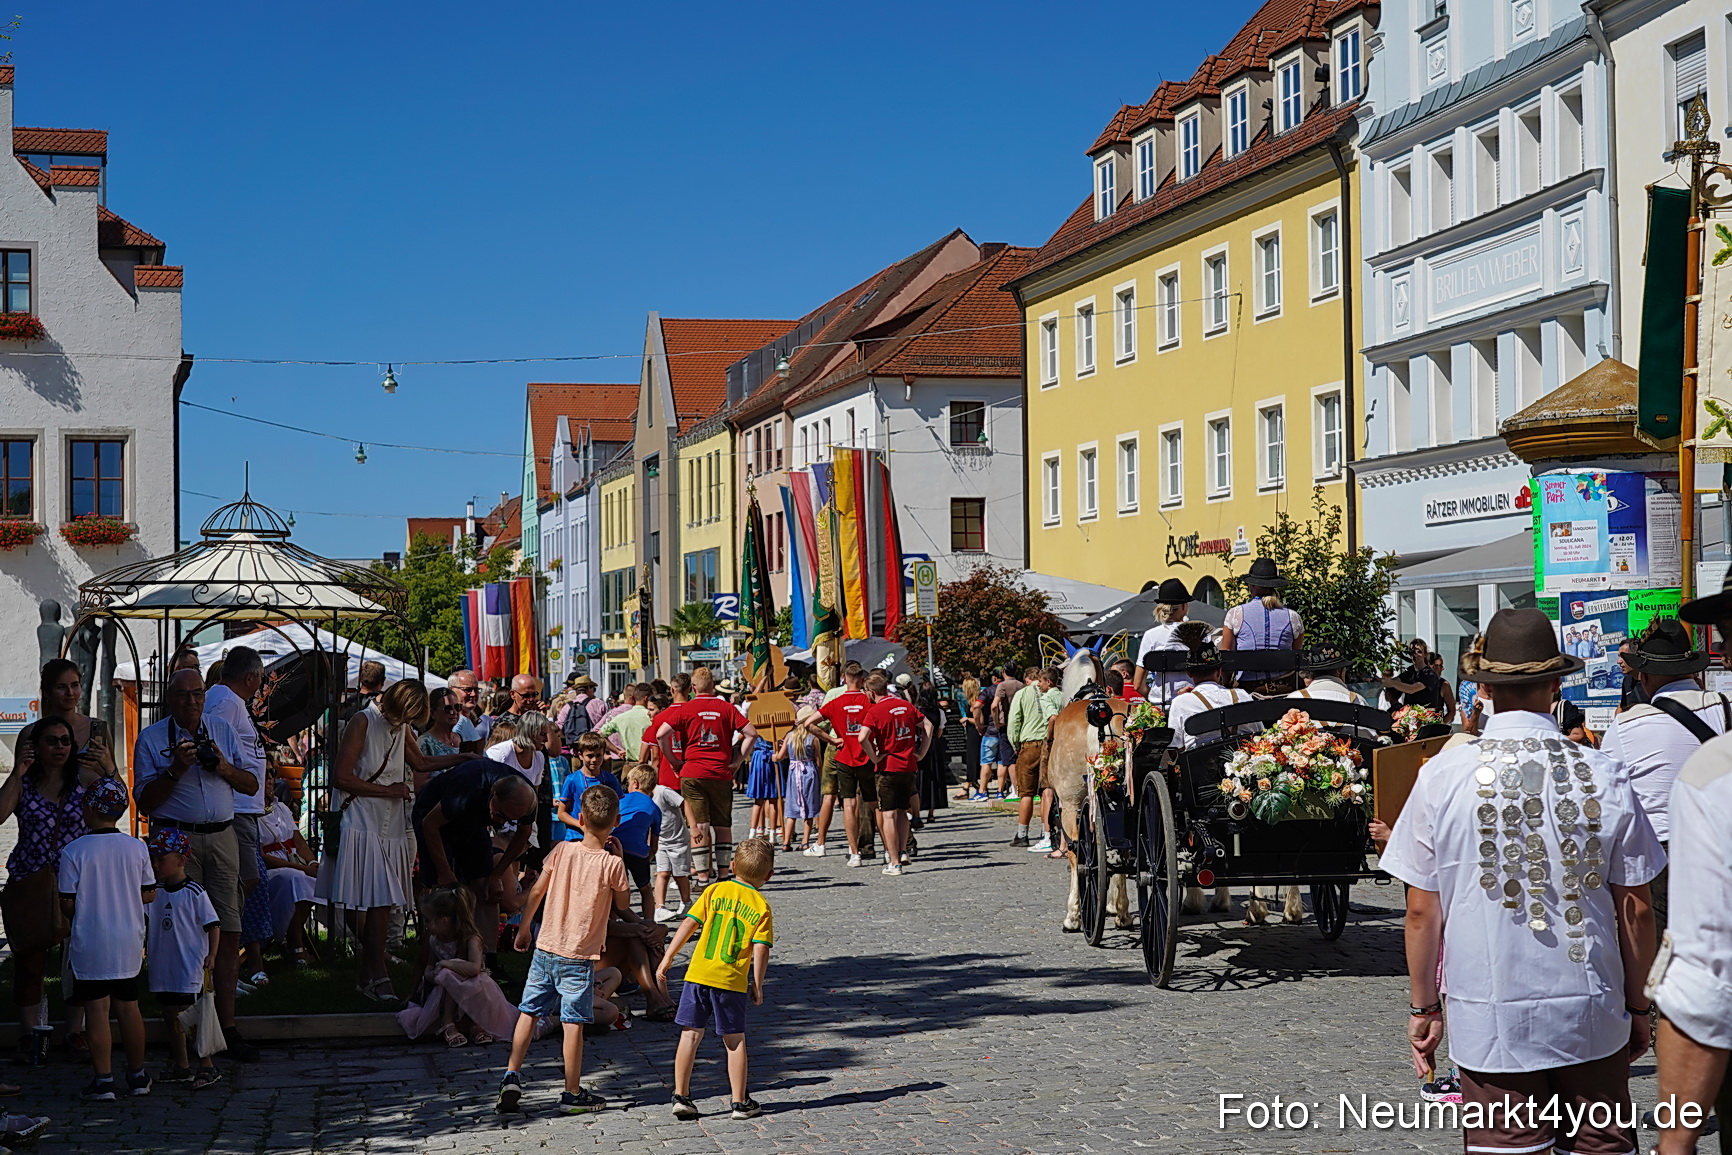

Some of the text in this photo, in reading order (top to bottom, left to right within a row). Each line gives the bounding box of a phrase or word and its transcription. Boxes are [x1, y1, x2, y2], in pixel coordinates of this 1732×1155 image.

[1436, 244, 1540, 305] BRILLEN WEBER
[1426, 492, 1512, 520] RÄTZER IMMOBILIEN
[1546, 491, 1566, 505] Park
[1635, 602, 1681, 611] Neumark
[0, 711, 27, 720] Kunst
[711, 898, 761, 926] ONADINHO
[704, 912, 746, 965] 10
